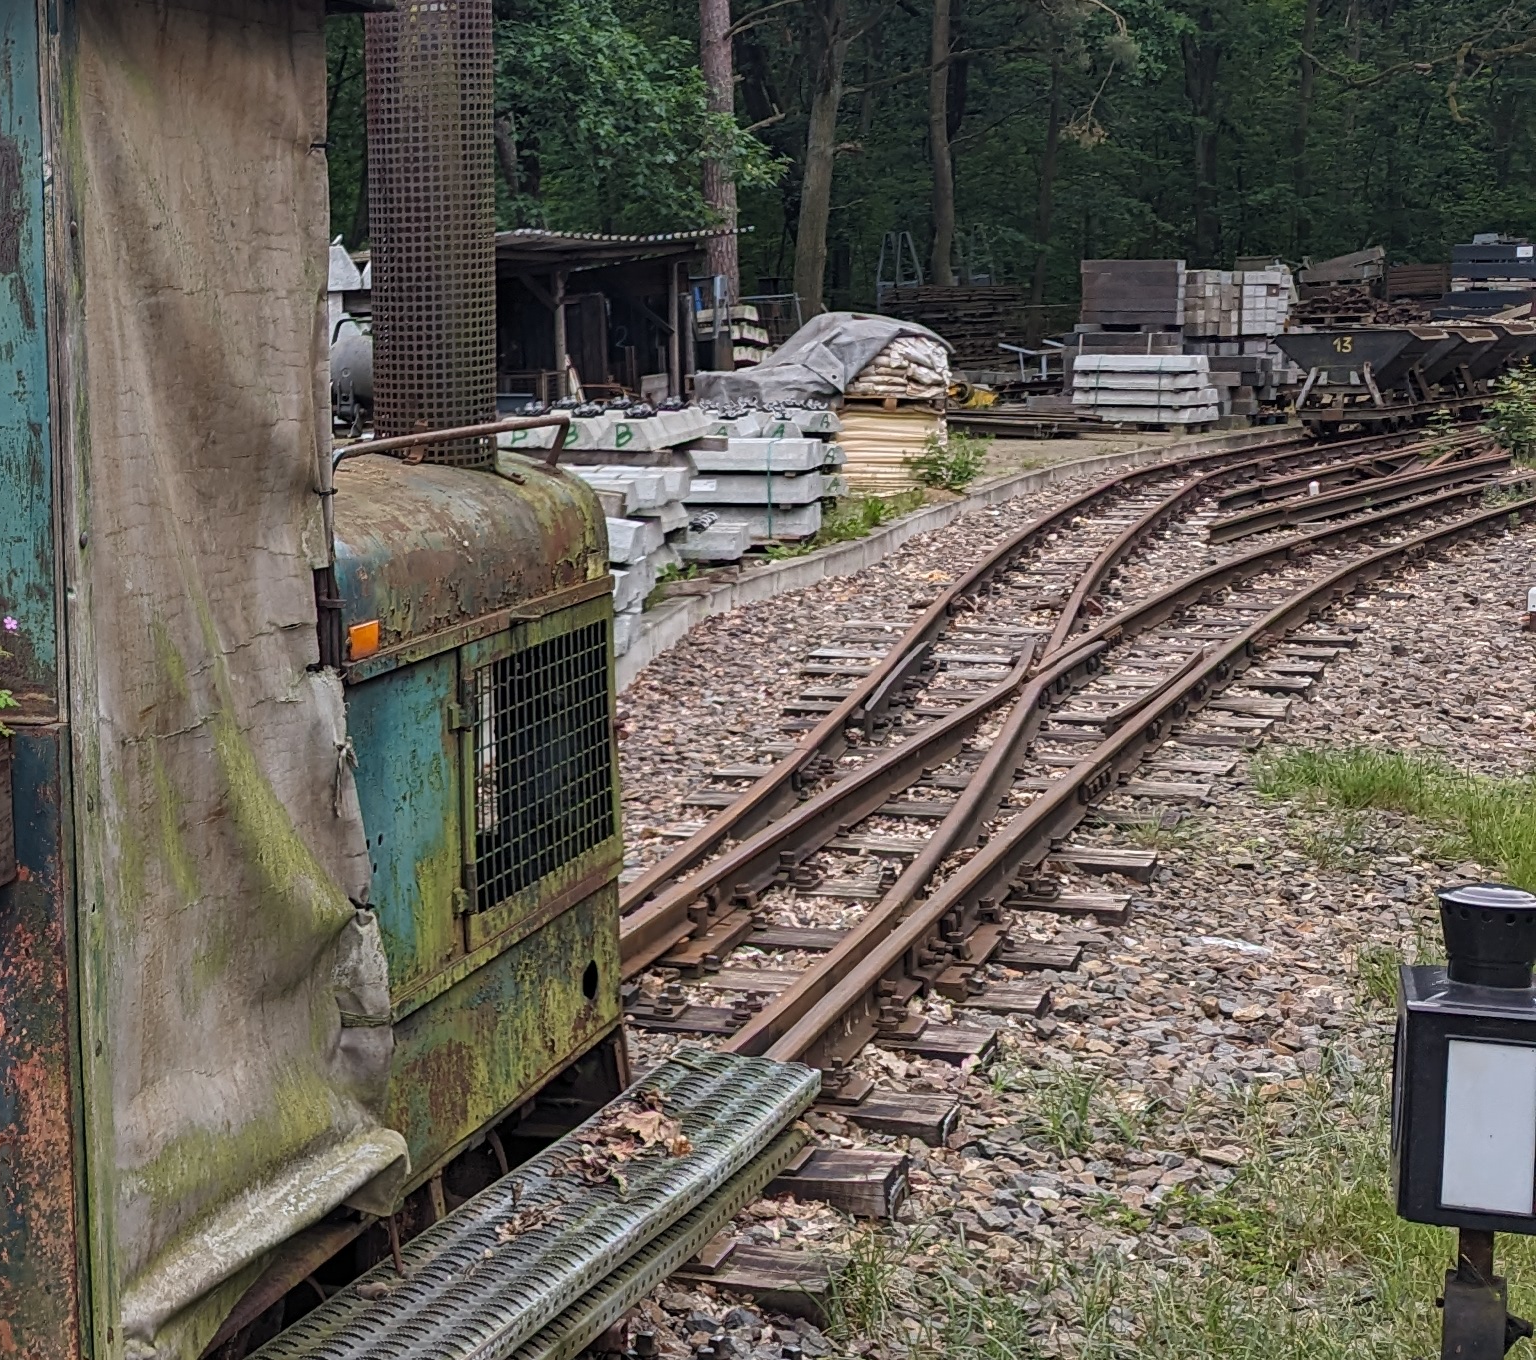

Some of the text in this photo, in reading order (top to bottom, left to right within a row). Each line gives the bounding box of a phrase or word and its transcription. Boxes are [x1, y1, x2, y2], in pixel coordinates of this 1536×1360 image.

[1332, 336, 1353, 353] 13
[819, 413, 831, 429] A
[615, 422, 633, 448] B
[771, 422, 785, 439] A
[823, 447, 837, 463] A
